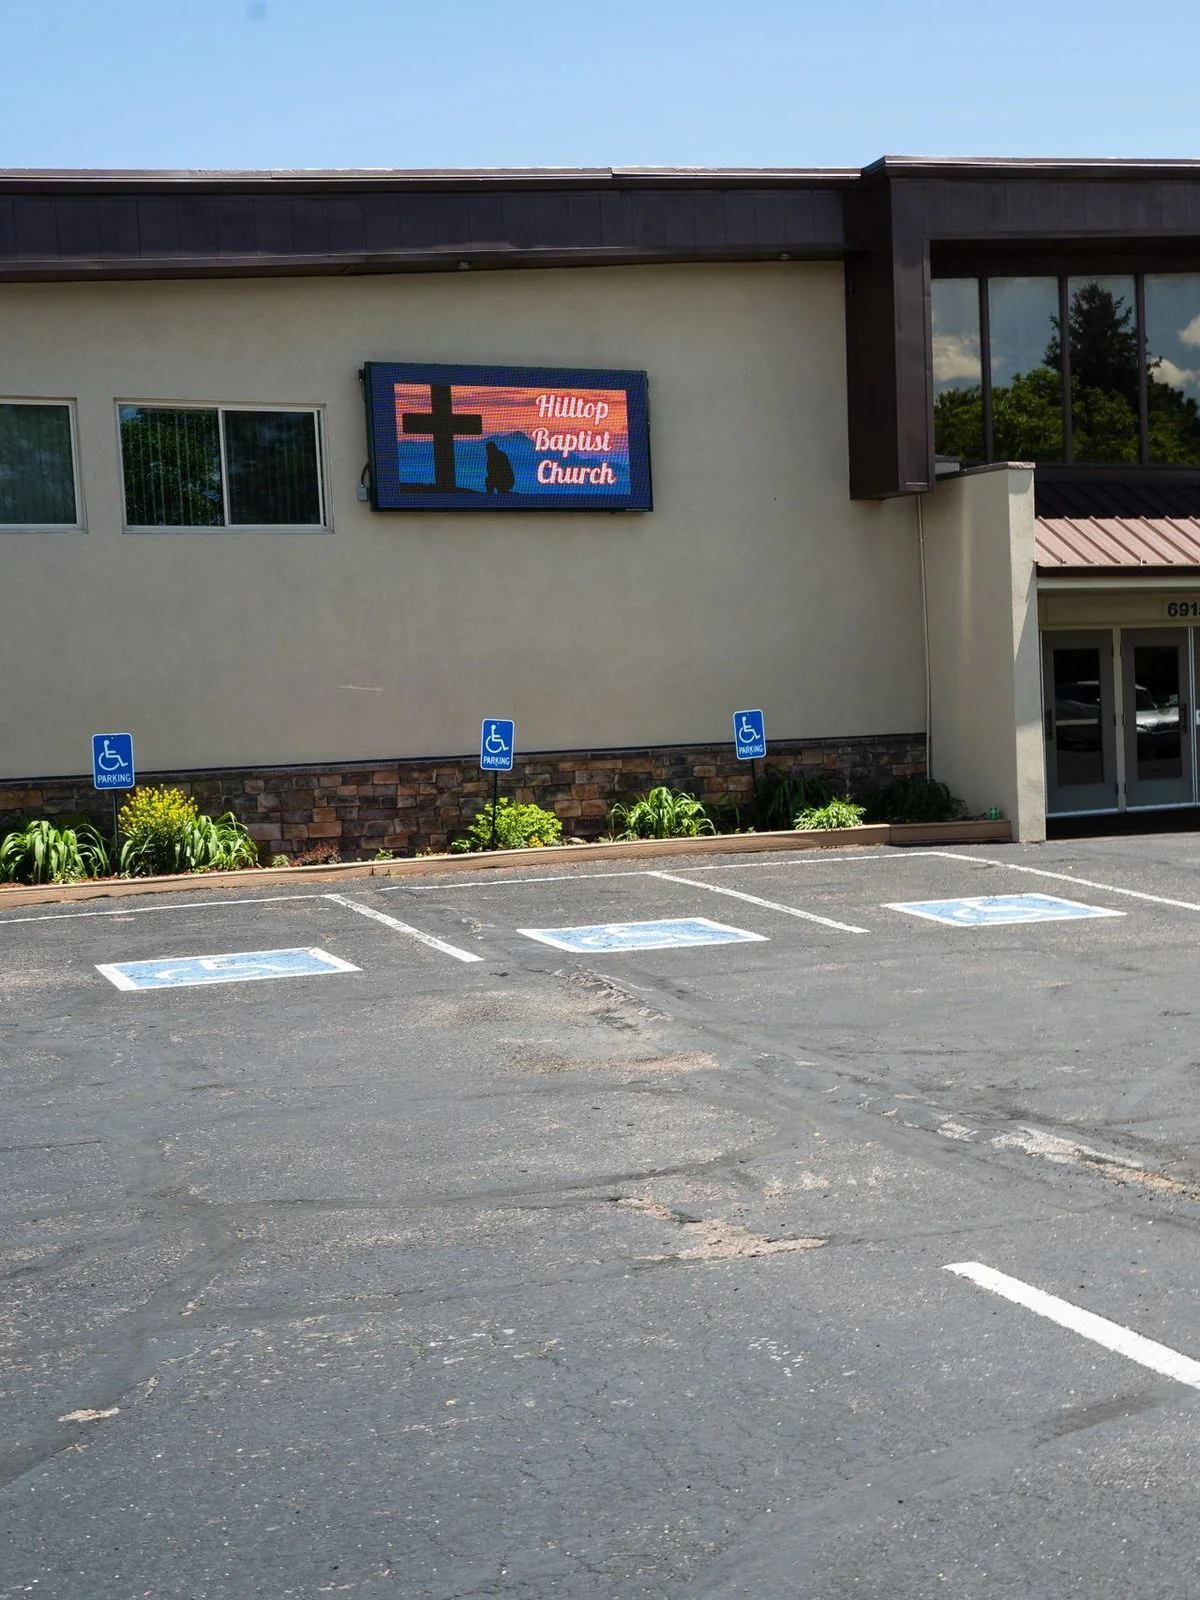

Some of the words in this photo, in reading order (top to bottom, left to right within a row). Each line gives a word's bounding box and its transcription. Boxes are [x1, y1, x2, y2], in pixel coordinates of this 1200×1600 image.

[535, 393, 609, 423] Hilltop
[532, 427, 612, 457] Baptist
[537, 459, 616, 485] Church
[739, 745, 764, 755] PARKING
[483, 756, 510, 766] PARKING
[97, 773, 131, 784] PARKING
